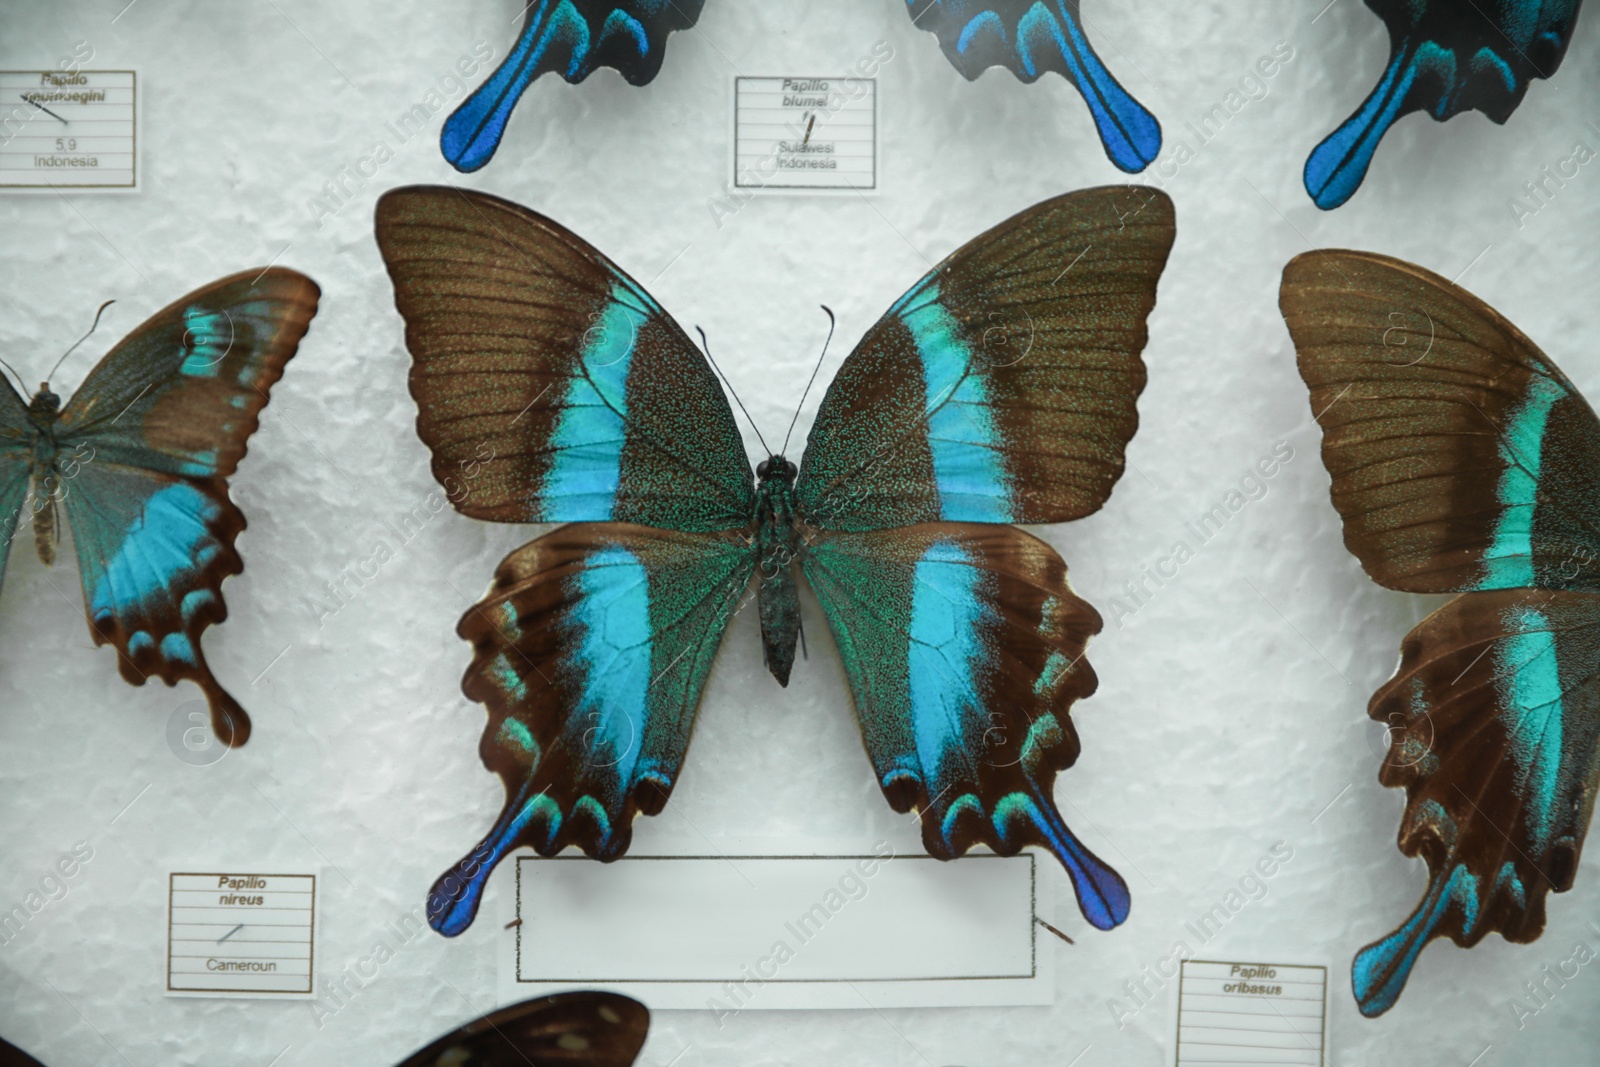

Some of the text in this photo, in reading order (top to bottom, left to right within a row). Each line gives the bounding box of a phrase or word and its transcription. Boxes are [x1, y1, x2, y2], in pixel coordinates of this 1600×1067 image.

[41, 71, 88, 86] Papilio
[782, 79, 829, 93] Papilio
[34, 155, 98, 167] Indonesia
[776, 157, 837, 169] Indonesia
[218, 876, 267, 891] Papilio
[219, 893, 264, 905] nireus
[206, 958, 277, 971] Cameroun
[1230, 965, 1277, 979] Papilio
[1223, 982, 1283, 995] oribasus
